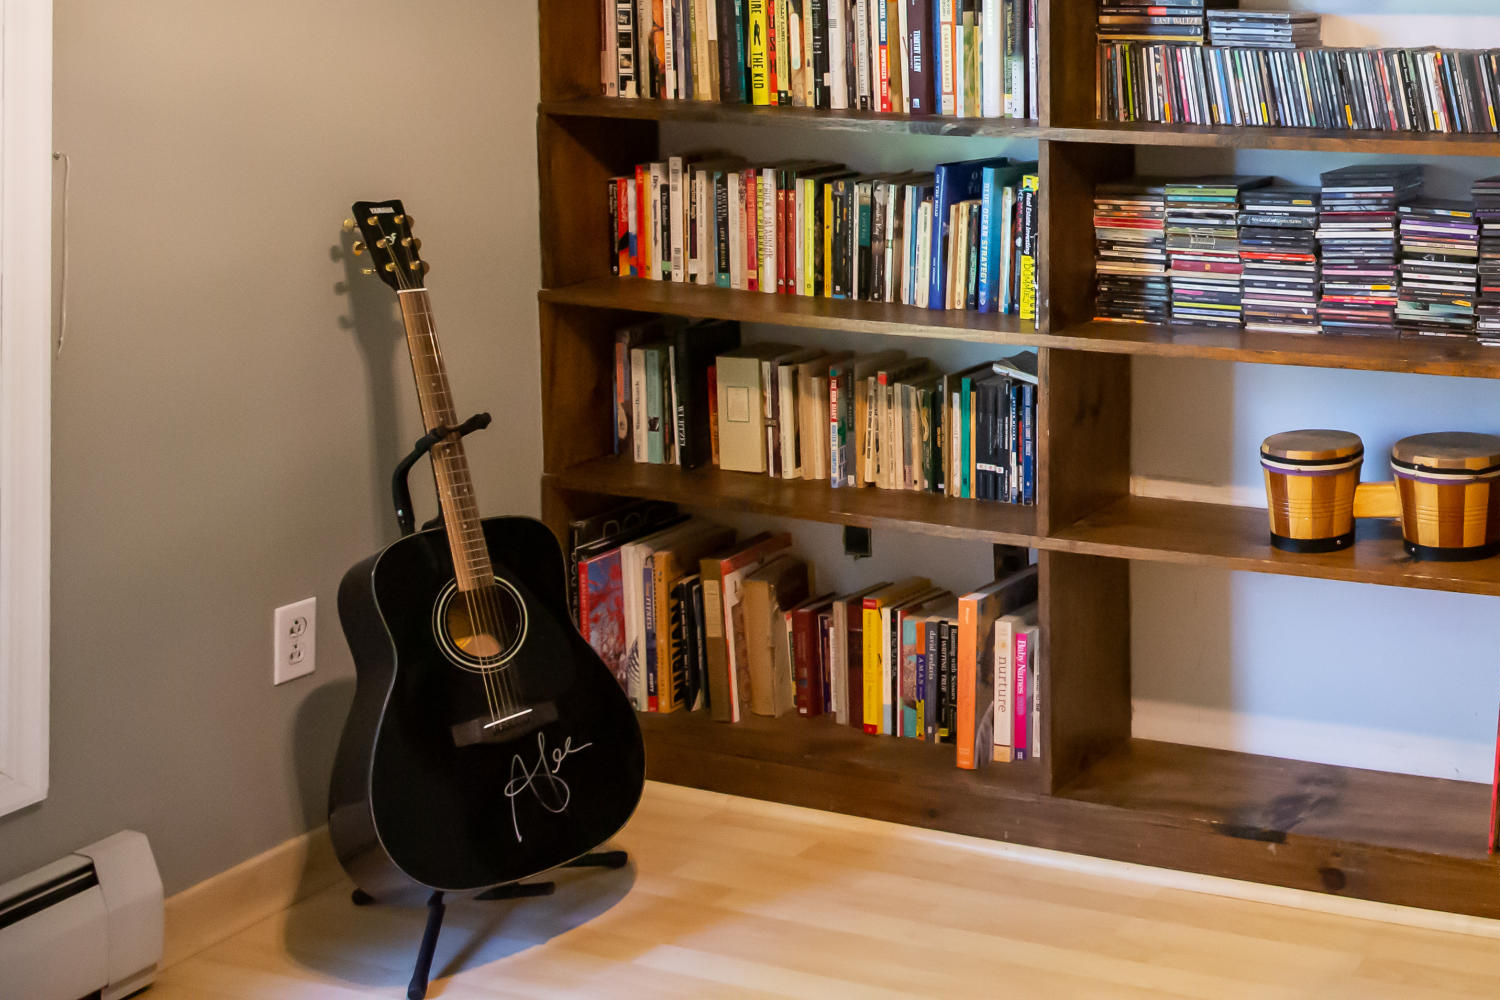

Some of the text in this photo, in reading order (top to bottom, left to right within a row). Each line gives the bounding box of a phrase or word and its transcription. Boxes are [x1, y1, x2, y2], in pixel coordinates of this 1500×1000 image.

[753, 52, 764, 89] THE KID
[913, 30, 921, 72] TIMOTHY LEARY
[934, 174, 940, 184] ON
[982, 208, 990, 237] OCEAN
[1024, 192, 1032, 255] Real Estate Investing
[980, 240, 988, 284] STRATEGY
[928, 630, 936, 680] david sedaris
[948, 628, 957, 700] Running with Scissors
[1016, 639, 1026, 694] Baby Names
[998, 656, 1008, 713] nurture
